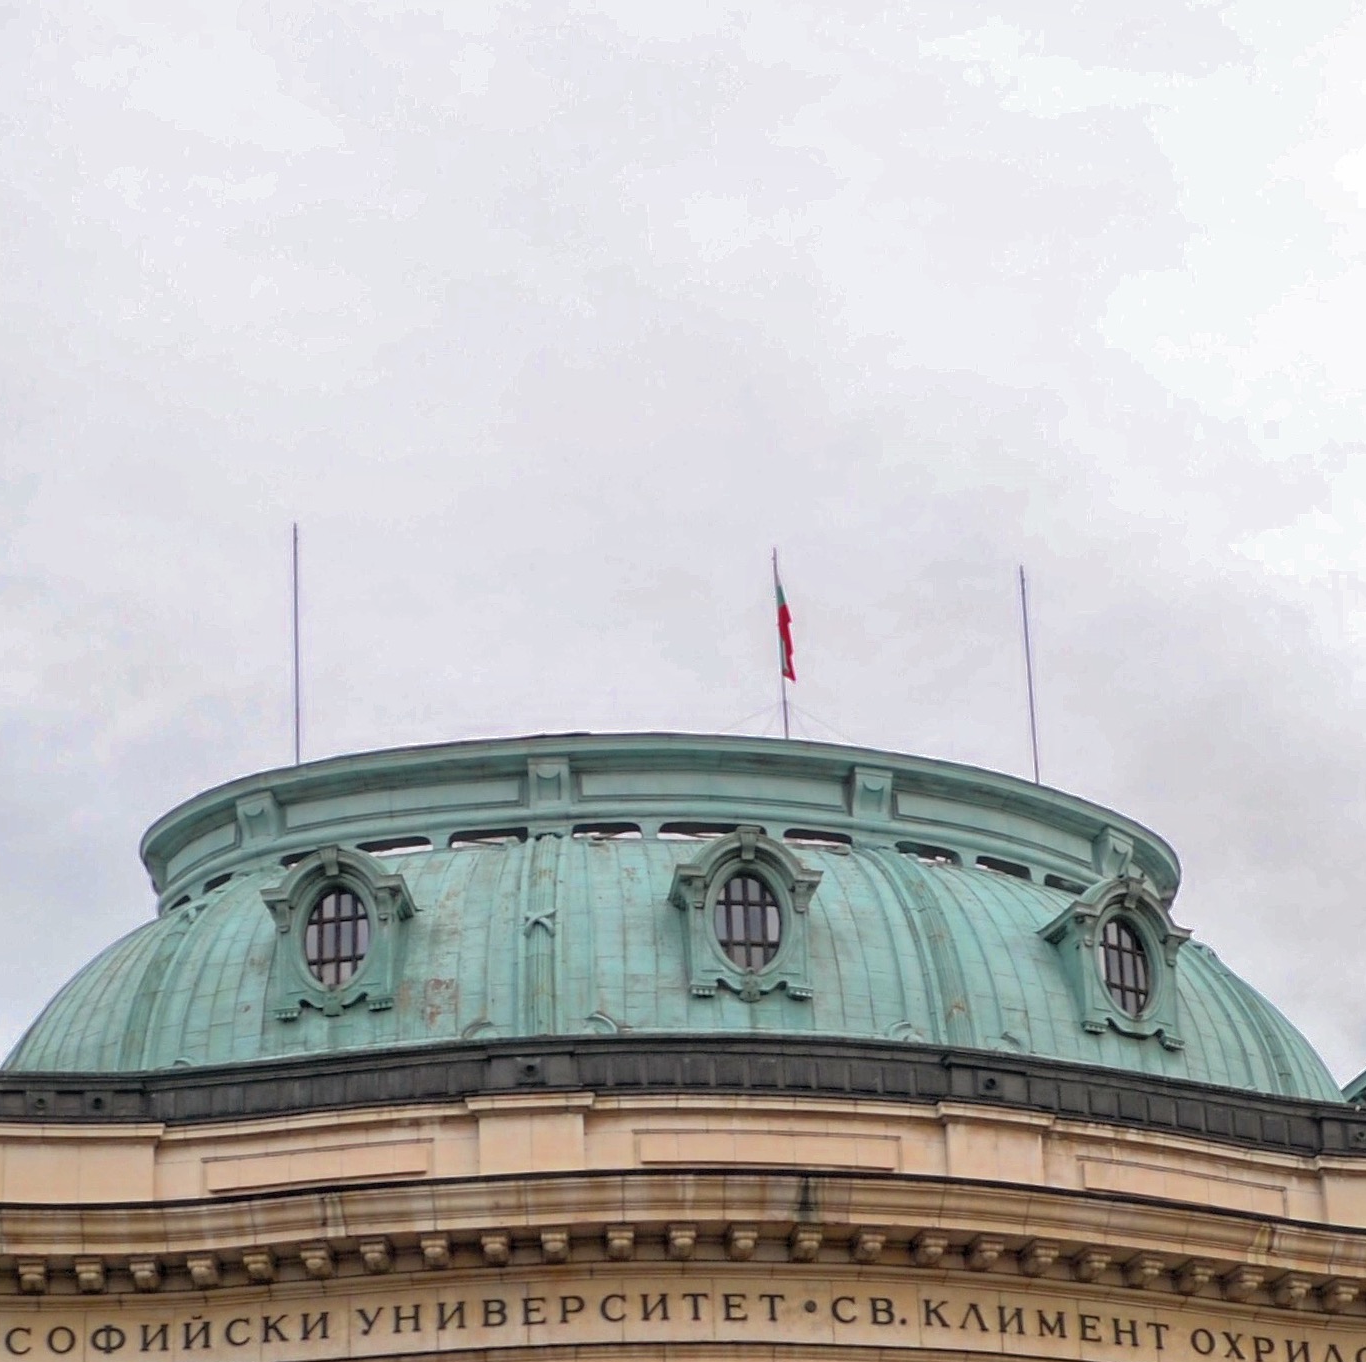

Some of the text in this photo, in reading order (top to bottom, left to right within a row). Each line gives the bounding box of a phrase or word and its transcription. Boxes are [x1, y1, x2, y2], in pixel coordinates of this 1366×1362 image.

[5, 1311, 331, 1357] СОФИЙСКИ
[356, 1293, 786, 1336] УНИВЕРСИТЕТ
[831, 1296, 908, 1327] СВ.
[924, 1299, 1170, 1351] КЛИМЕНТ
